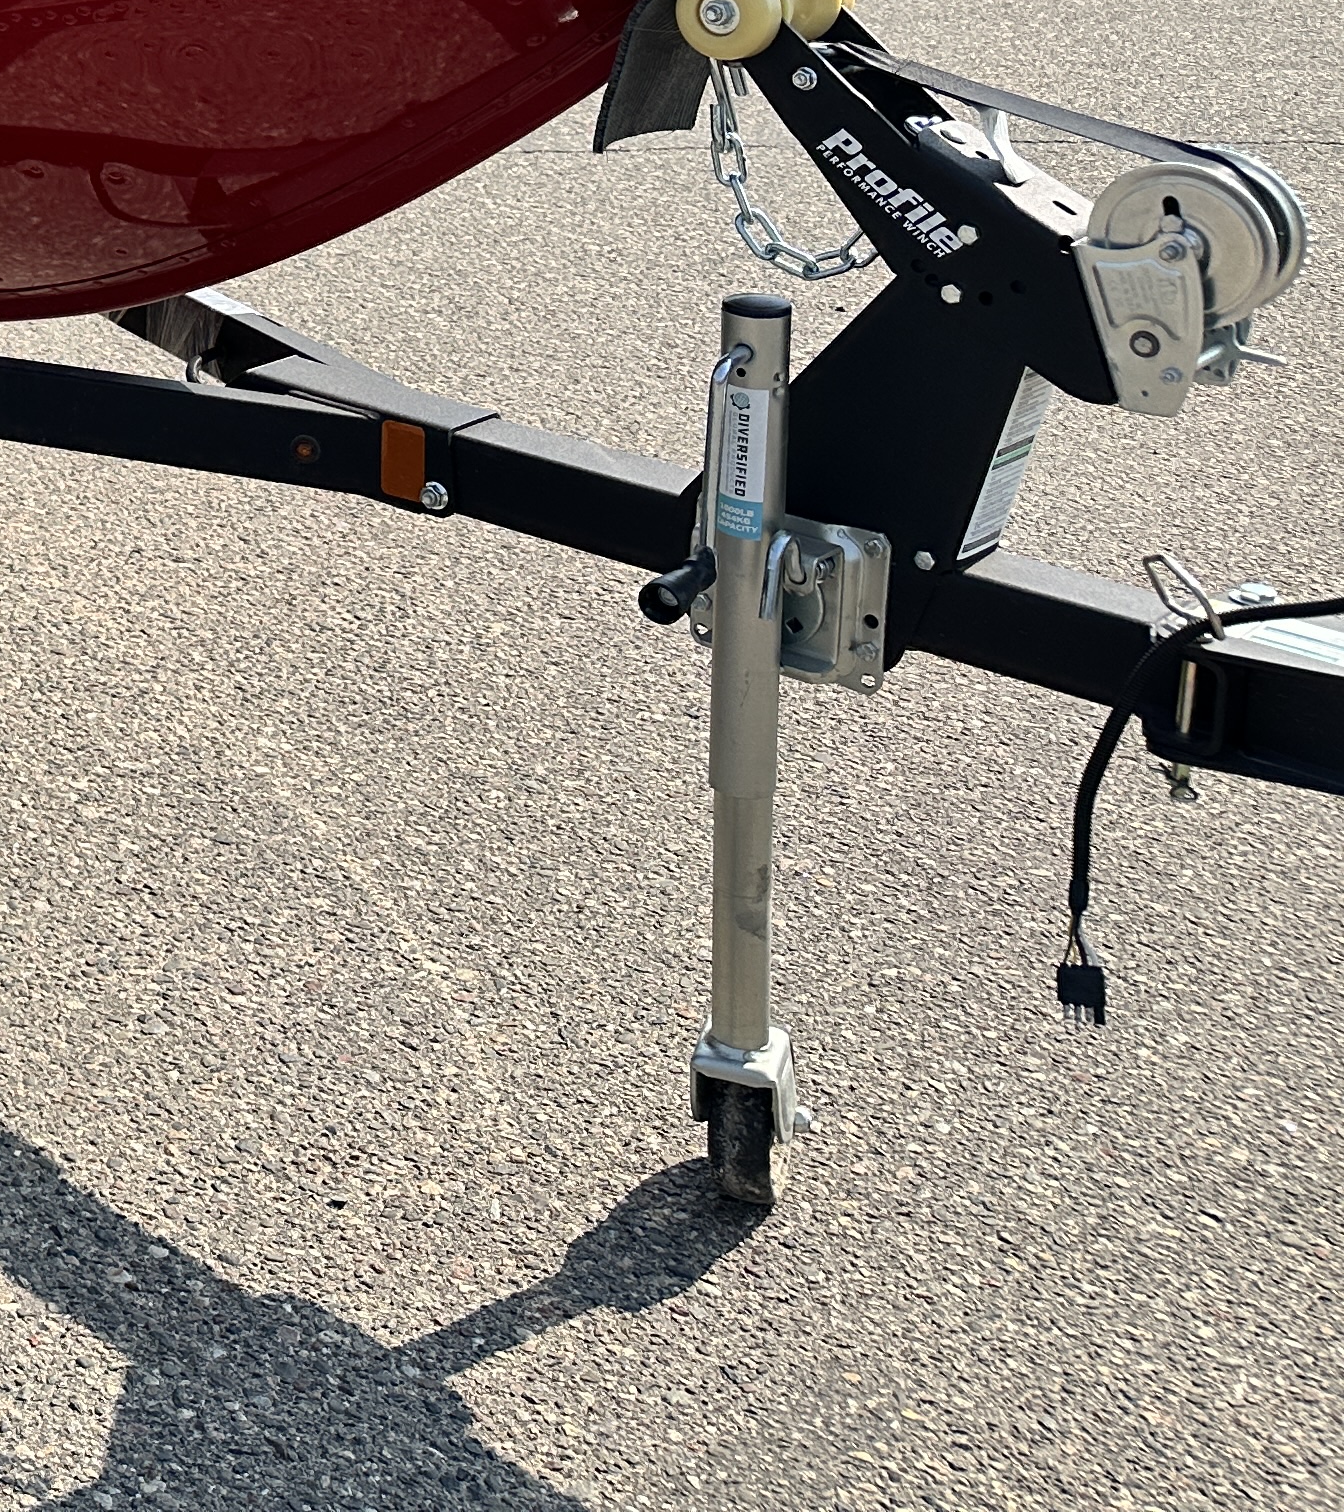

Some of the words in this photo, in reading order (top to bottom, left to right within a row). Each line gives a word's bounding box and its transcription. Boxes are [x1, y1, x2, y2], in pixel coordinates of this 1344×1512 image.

[815, 144, 903, 220] PERFORMANCE
[902, 219, 946, 258] WINCH
[821, 128, 964, 254] Profile
[734, 412, 750, 497] DIVERSIFIED
